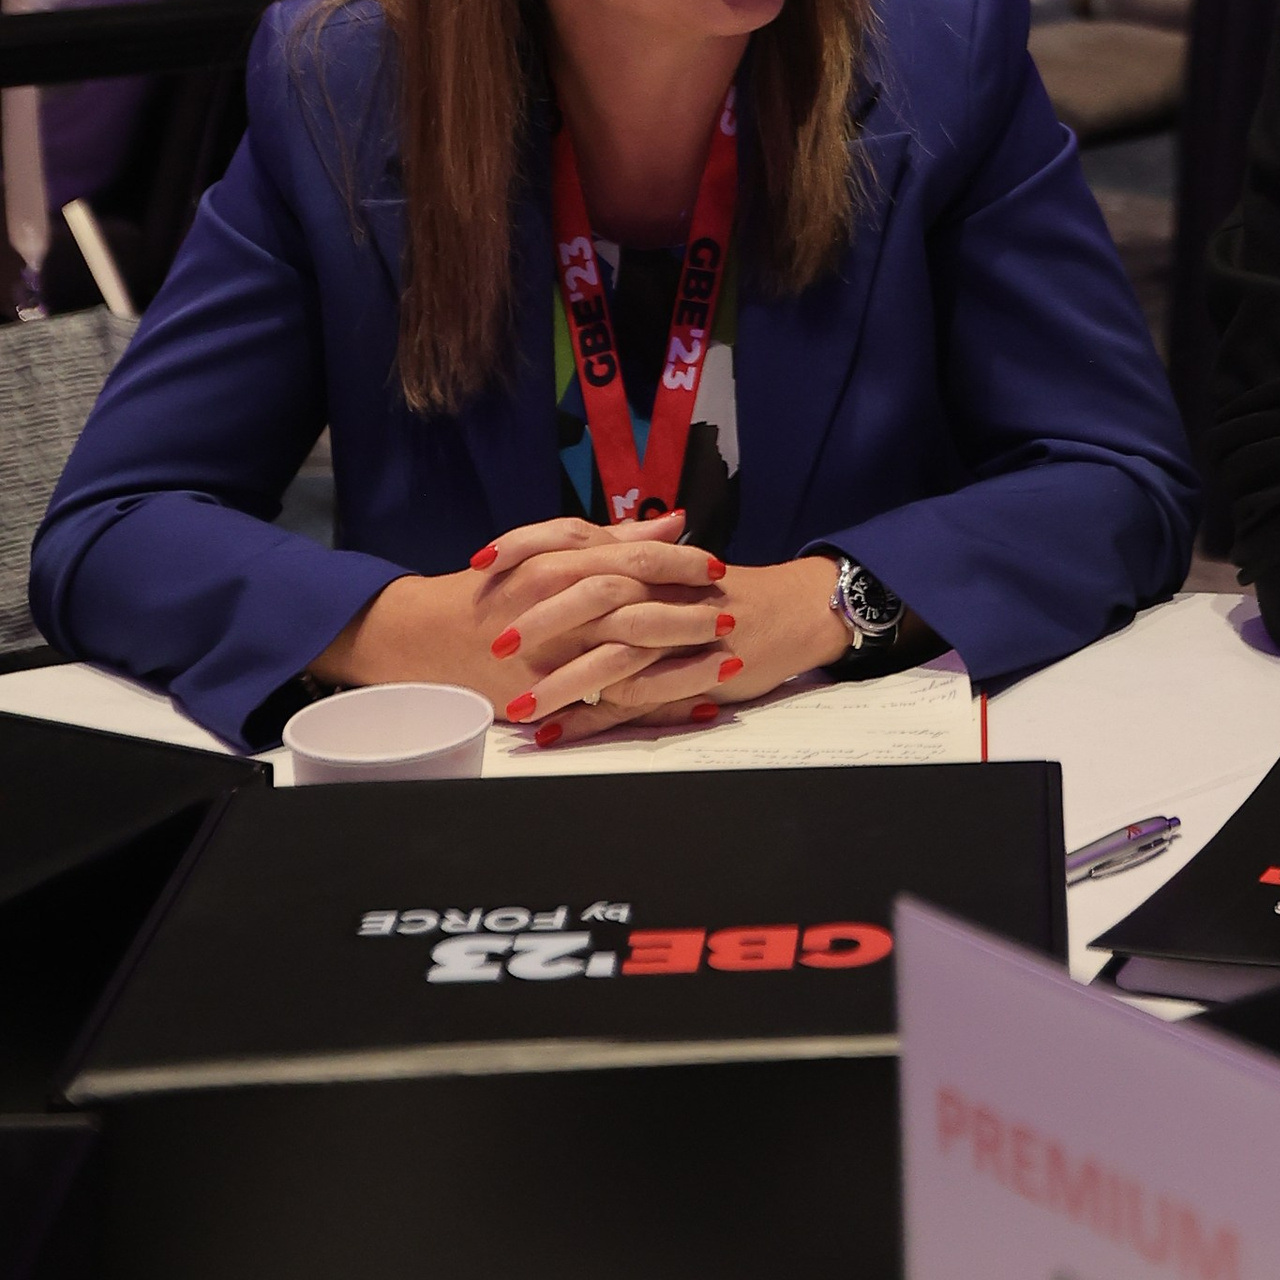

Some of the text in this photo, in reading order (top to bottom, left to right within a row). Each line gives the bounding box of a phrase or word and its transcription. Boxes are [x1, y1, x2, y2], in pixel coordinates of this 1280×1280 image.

[558, 236, 617, 389] GBE'23
[662, 236, 721, 392] GBE'23
[356, 901, 631, 937] by FORCE
[427, 922, 893, 984] GBE'23
[936, 1085, 1241, 1280] PREMIUM
